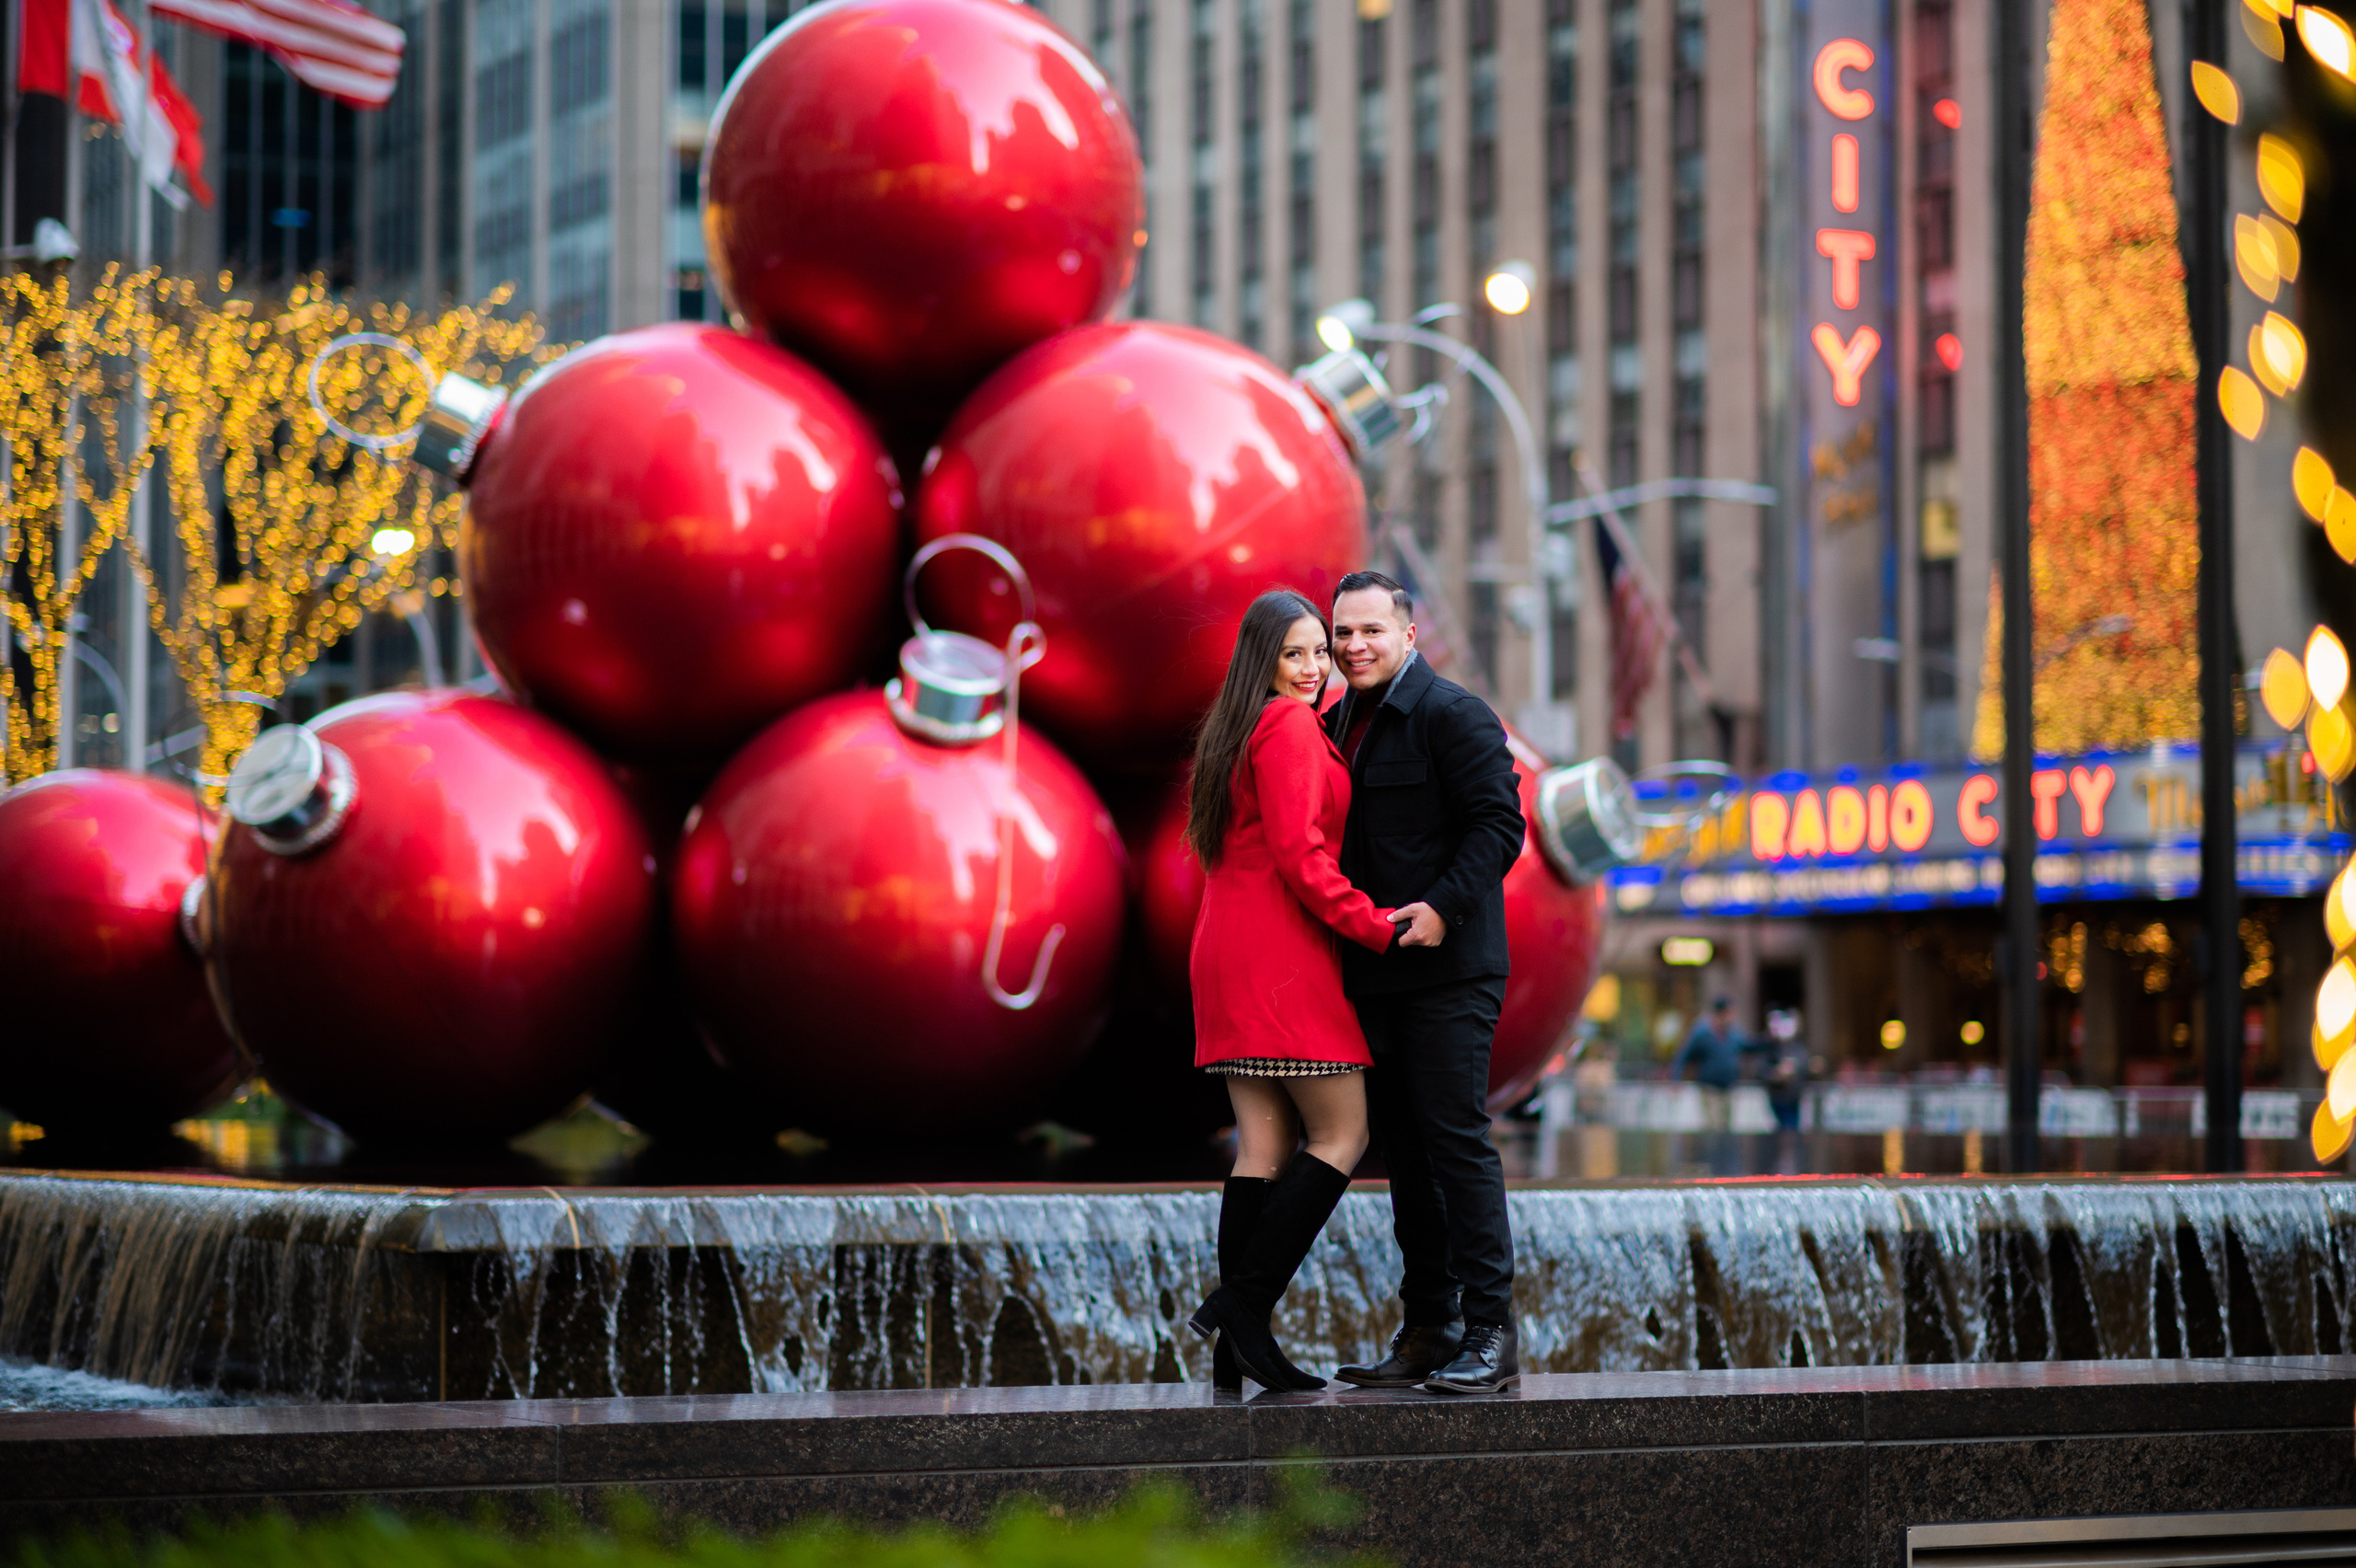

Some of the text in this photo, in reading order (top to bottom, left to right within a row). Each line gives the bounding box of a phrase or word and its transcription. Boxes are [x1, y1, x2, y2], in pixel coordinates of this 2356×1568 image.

[1811, 38, 1881, 407] CITY
[1750, 779, 1934, 861] RADIO
[1958, 764, 2115, 847] CTY
